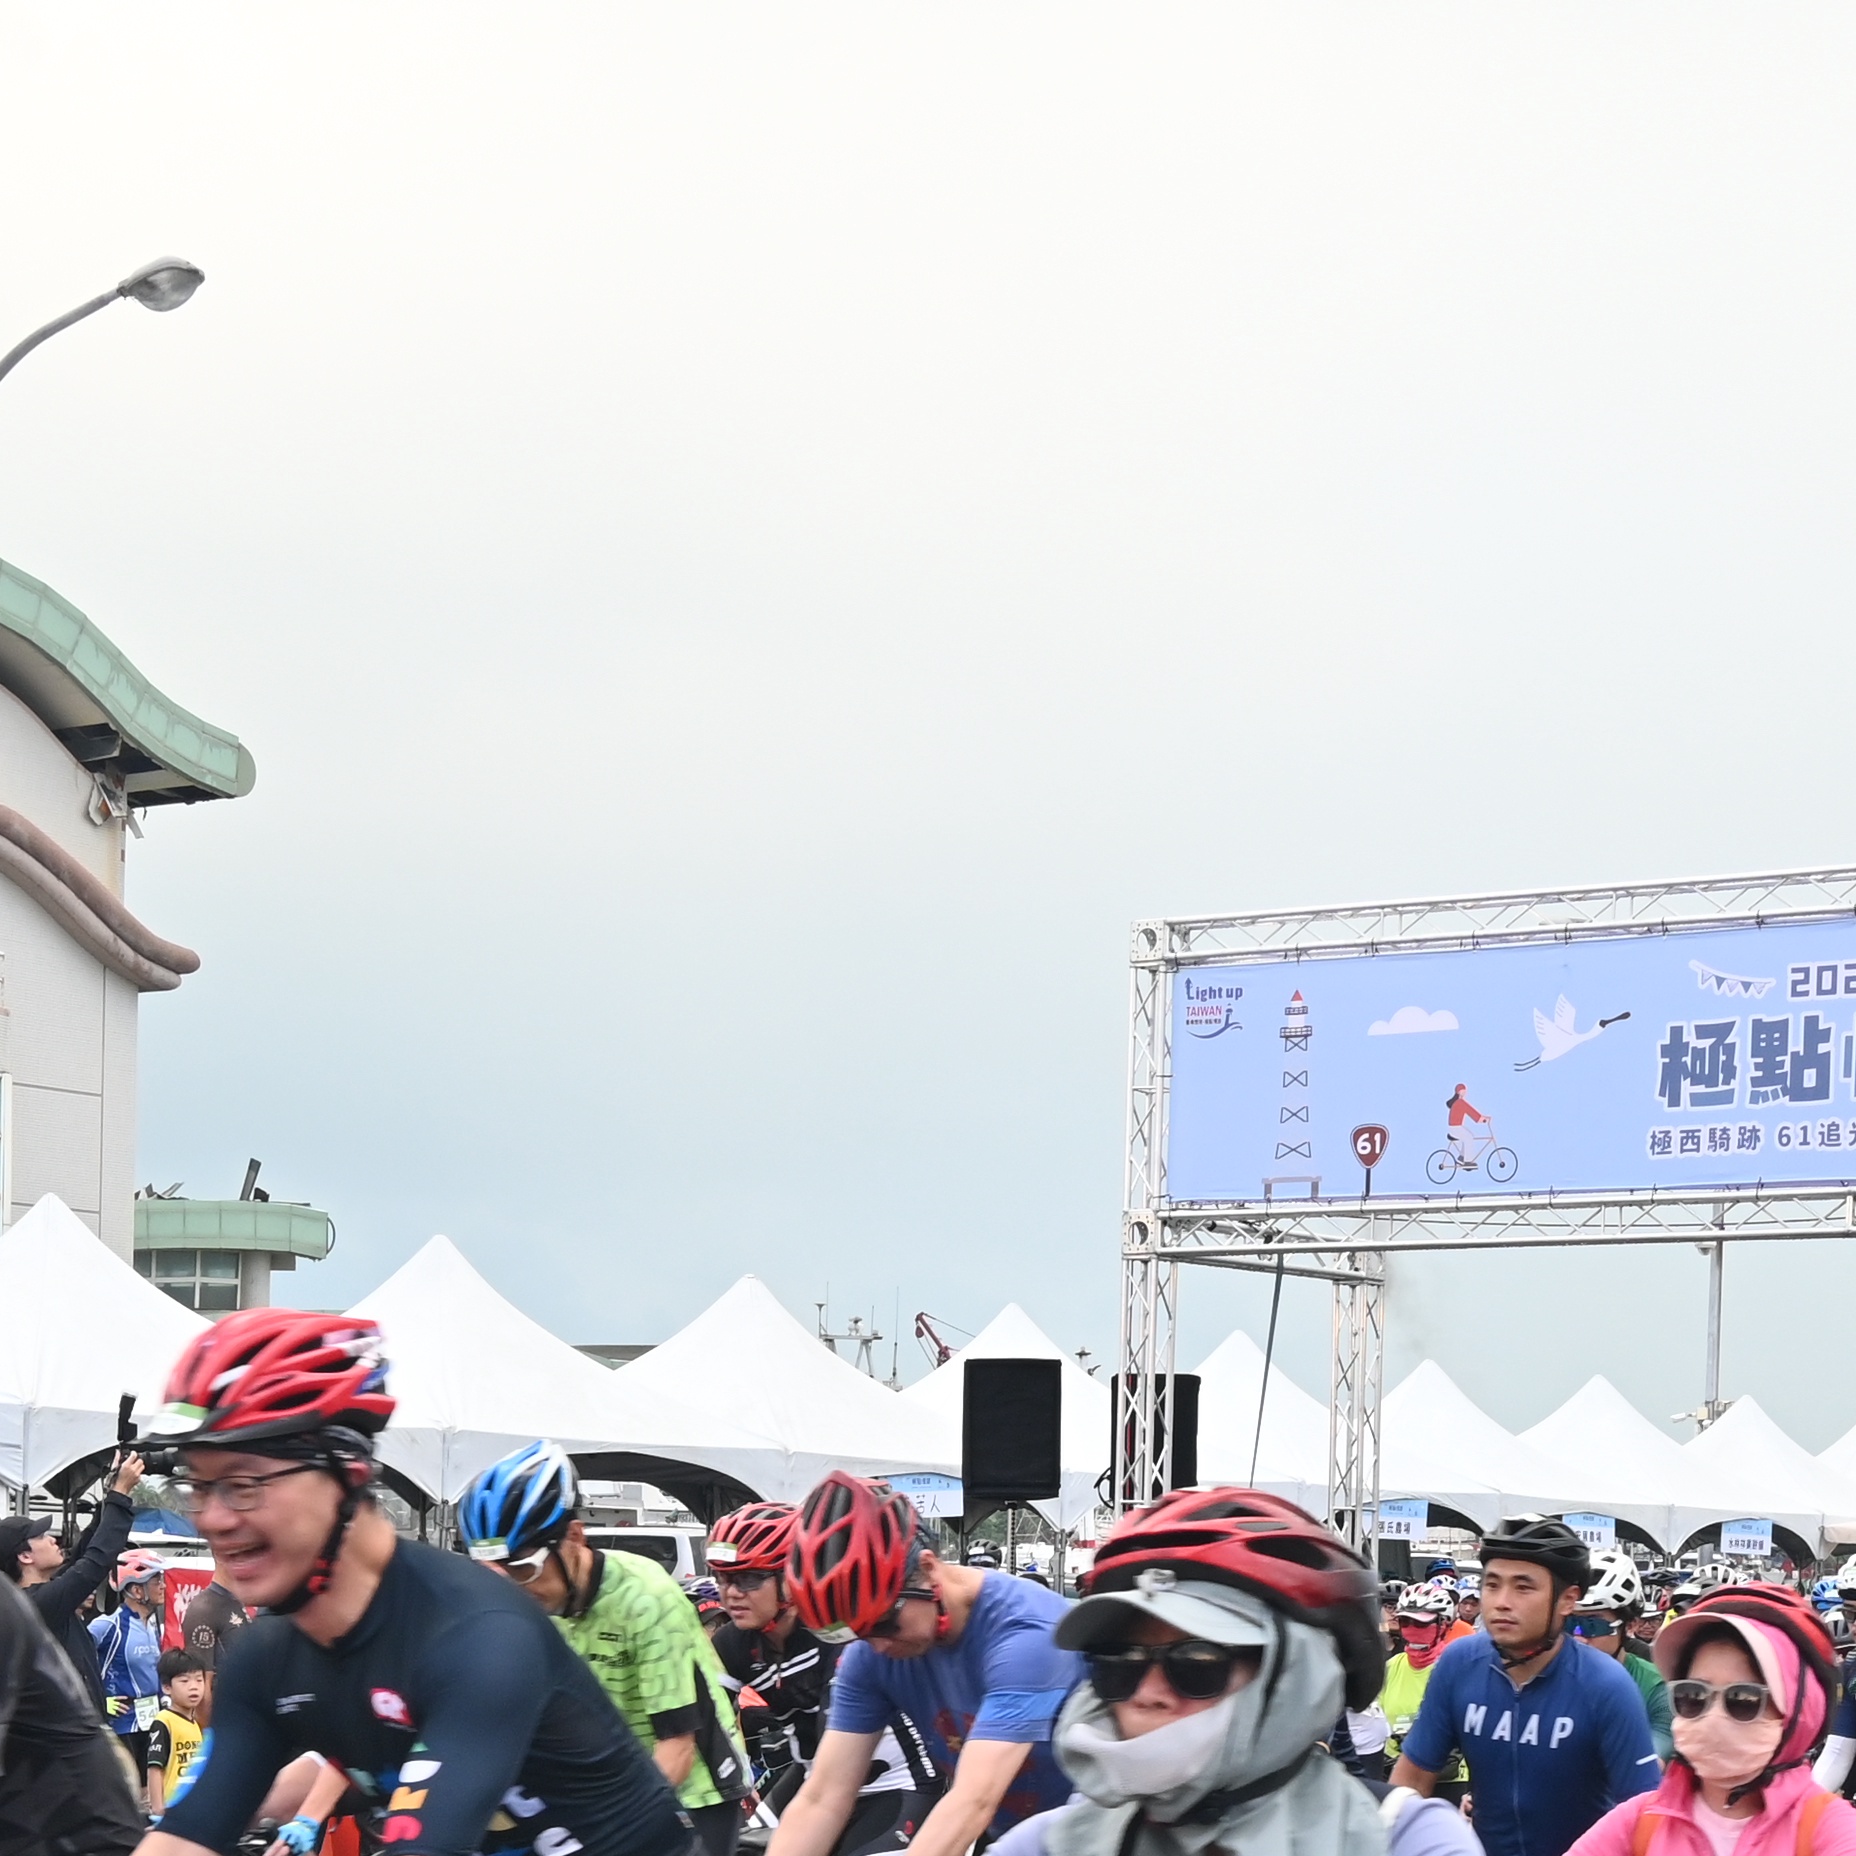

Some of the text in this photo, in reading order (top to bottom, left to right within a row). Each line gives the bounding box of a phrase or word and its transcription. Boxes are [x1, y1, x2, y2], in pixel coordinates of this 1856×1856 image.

[1185, 978, 1243, 1002] Light up
[1186, 1005, 1222, 1017] TAIWAN
[1356, 1130, 1384, 1158] 61
[1649, 1124, 1762, 1156] 極西騎跡
[1462, 1703, 1575, 1750] MAAP
